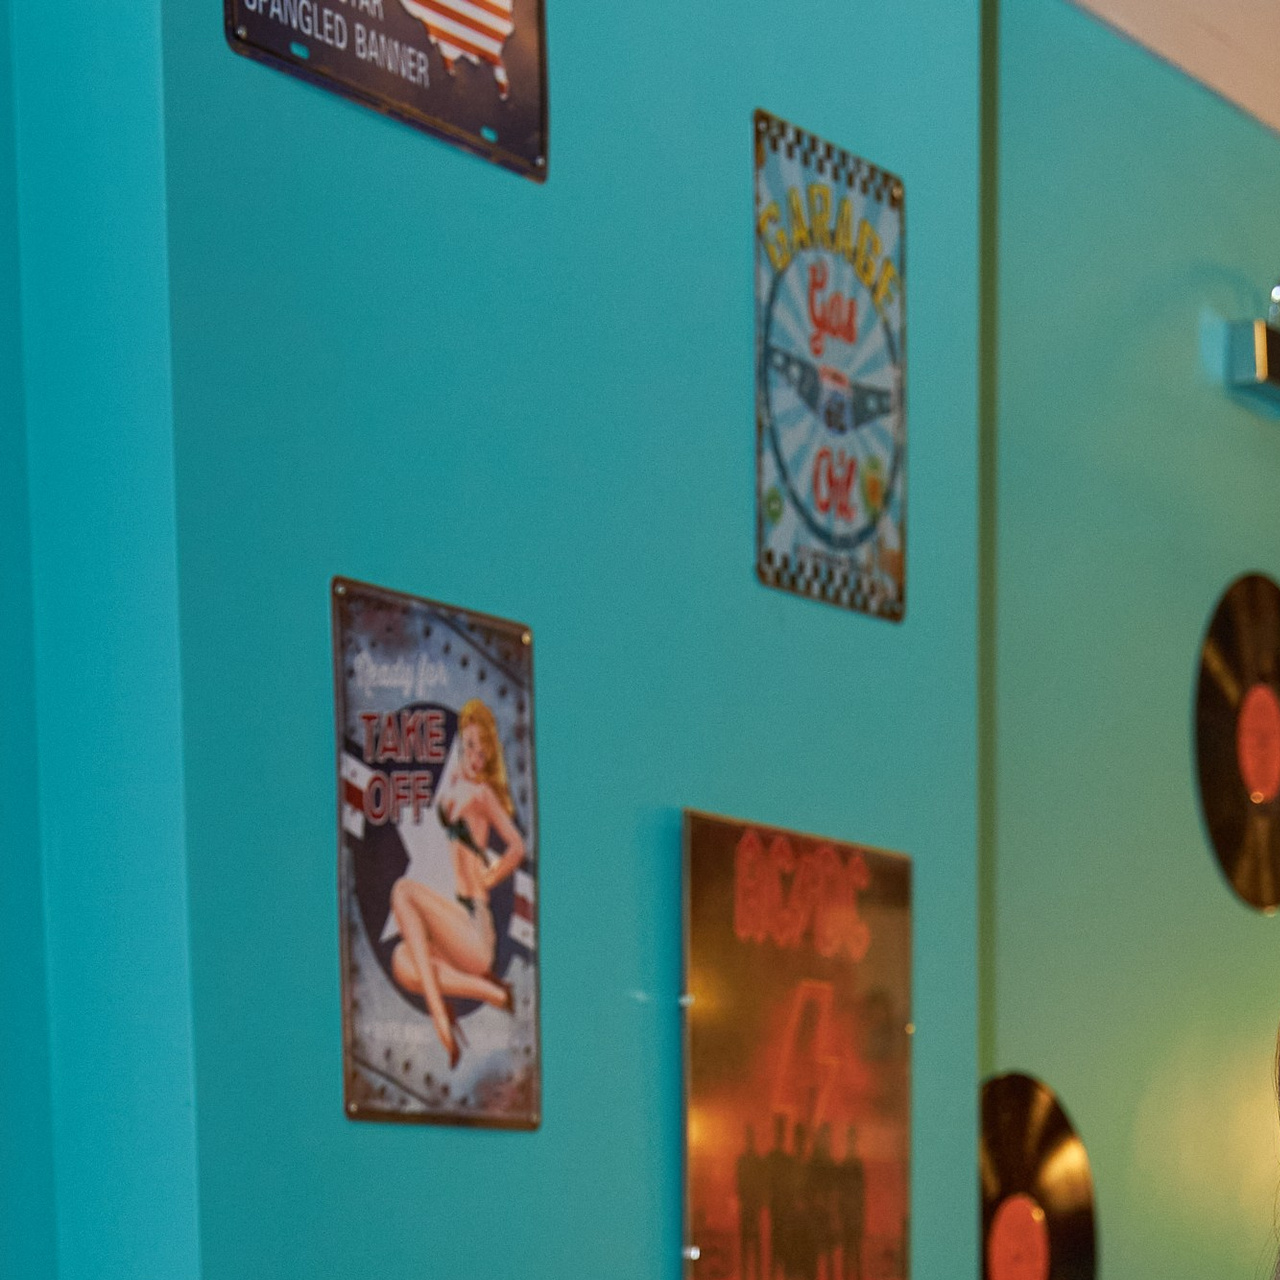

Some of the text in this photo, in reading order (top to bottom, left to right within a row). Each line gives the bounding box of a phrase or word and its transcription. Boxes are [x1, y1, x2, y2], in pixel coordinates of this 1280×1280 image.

[355, 22, 431, 88] BANNER
[759, 184, 901, 312] GARAGE
[360, 710, 446, 764] TAKE
[364, 770, 433, 827] OFF
